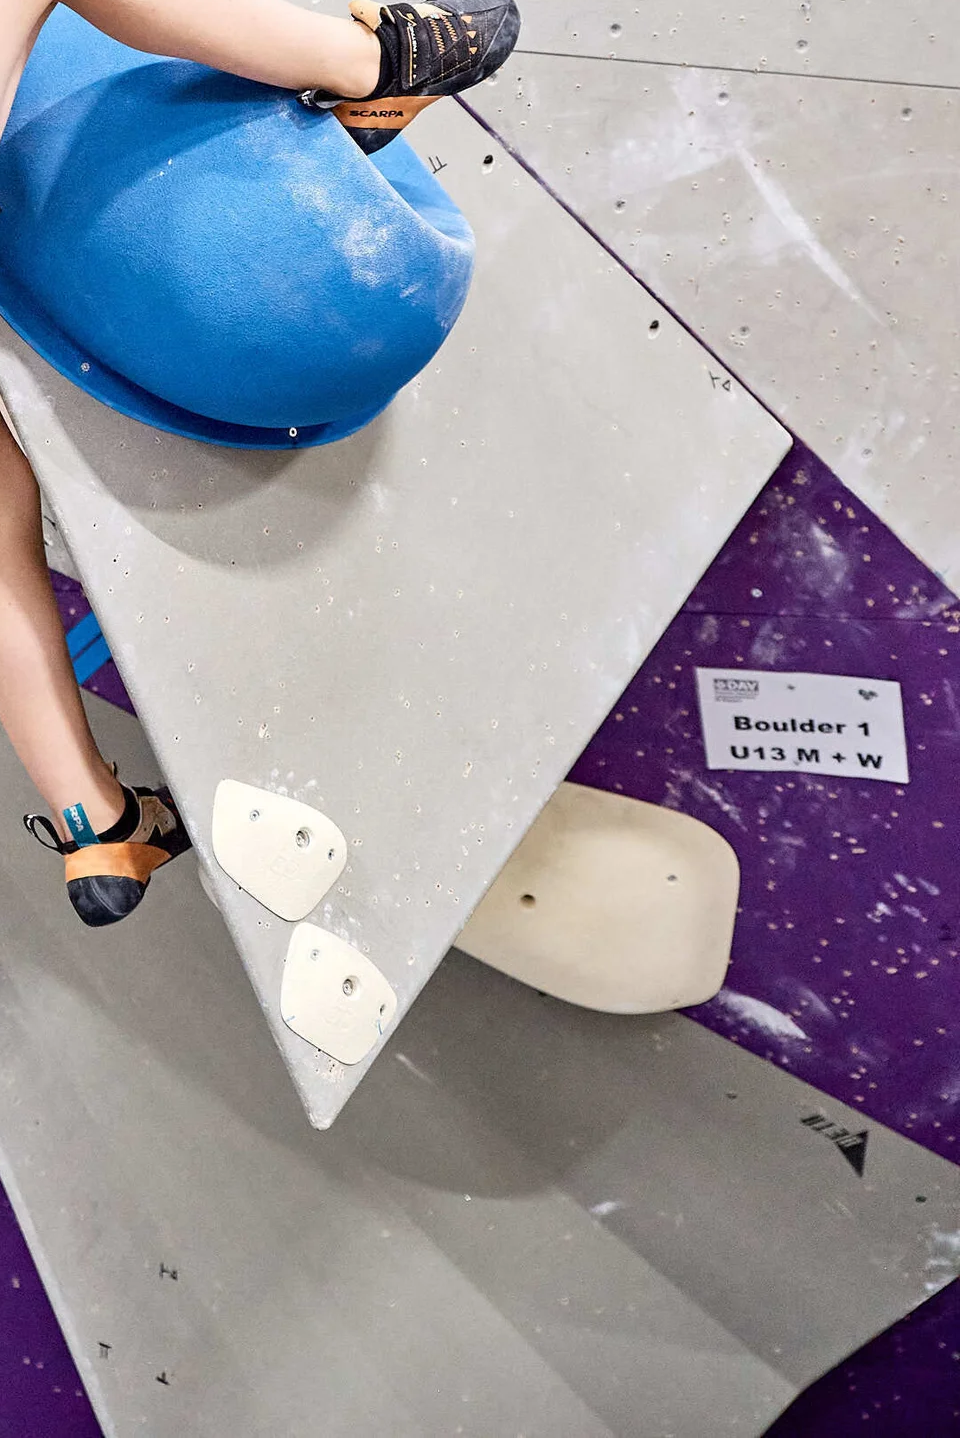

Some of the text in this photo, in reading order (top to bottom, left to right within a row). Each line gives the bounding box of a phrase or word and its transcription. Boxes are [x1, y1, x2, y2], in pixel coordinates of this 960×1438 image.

[349, 110, 404, 118] SCARPA
[733, 716, 871, 737] Boulder 1
[730, 745, 786, 761] U13
[797, 748, 820, 763] M
[856, 753, 883, 769] W
